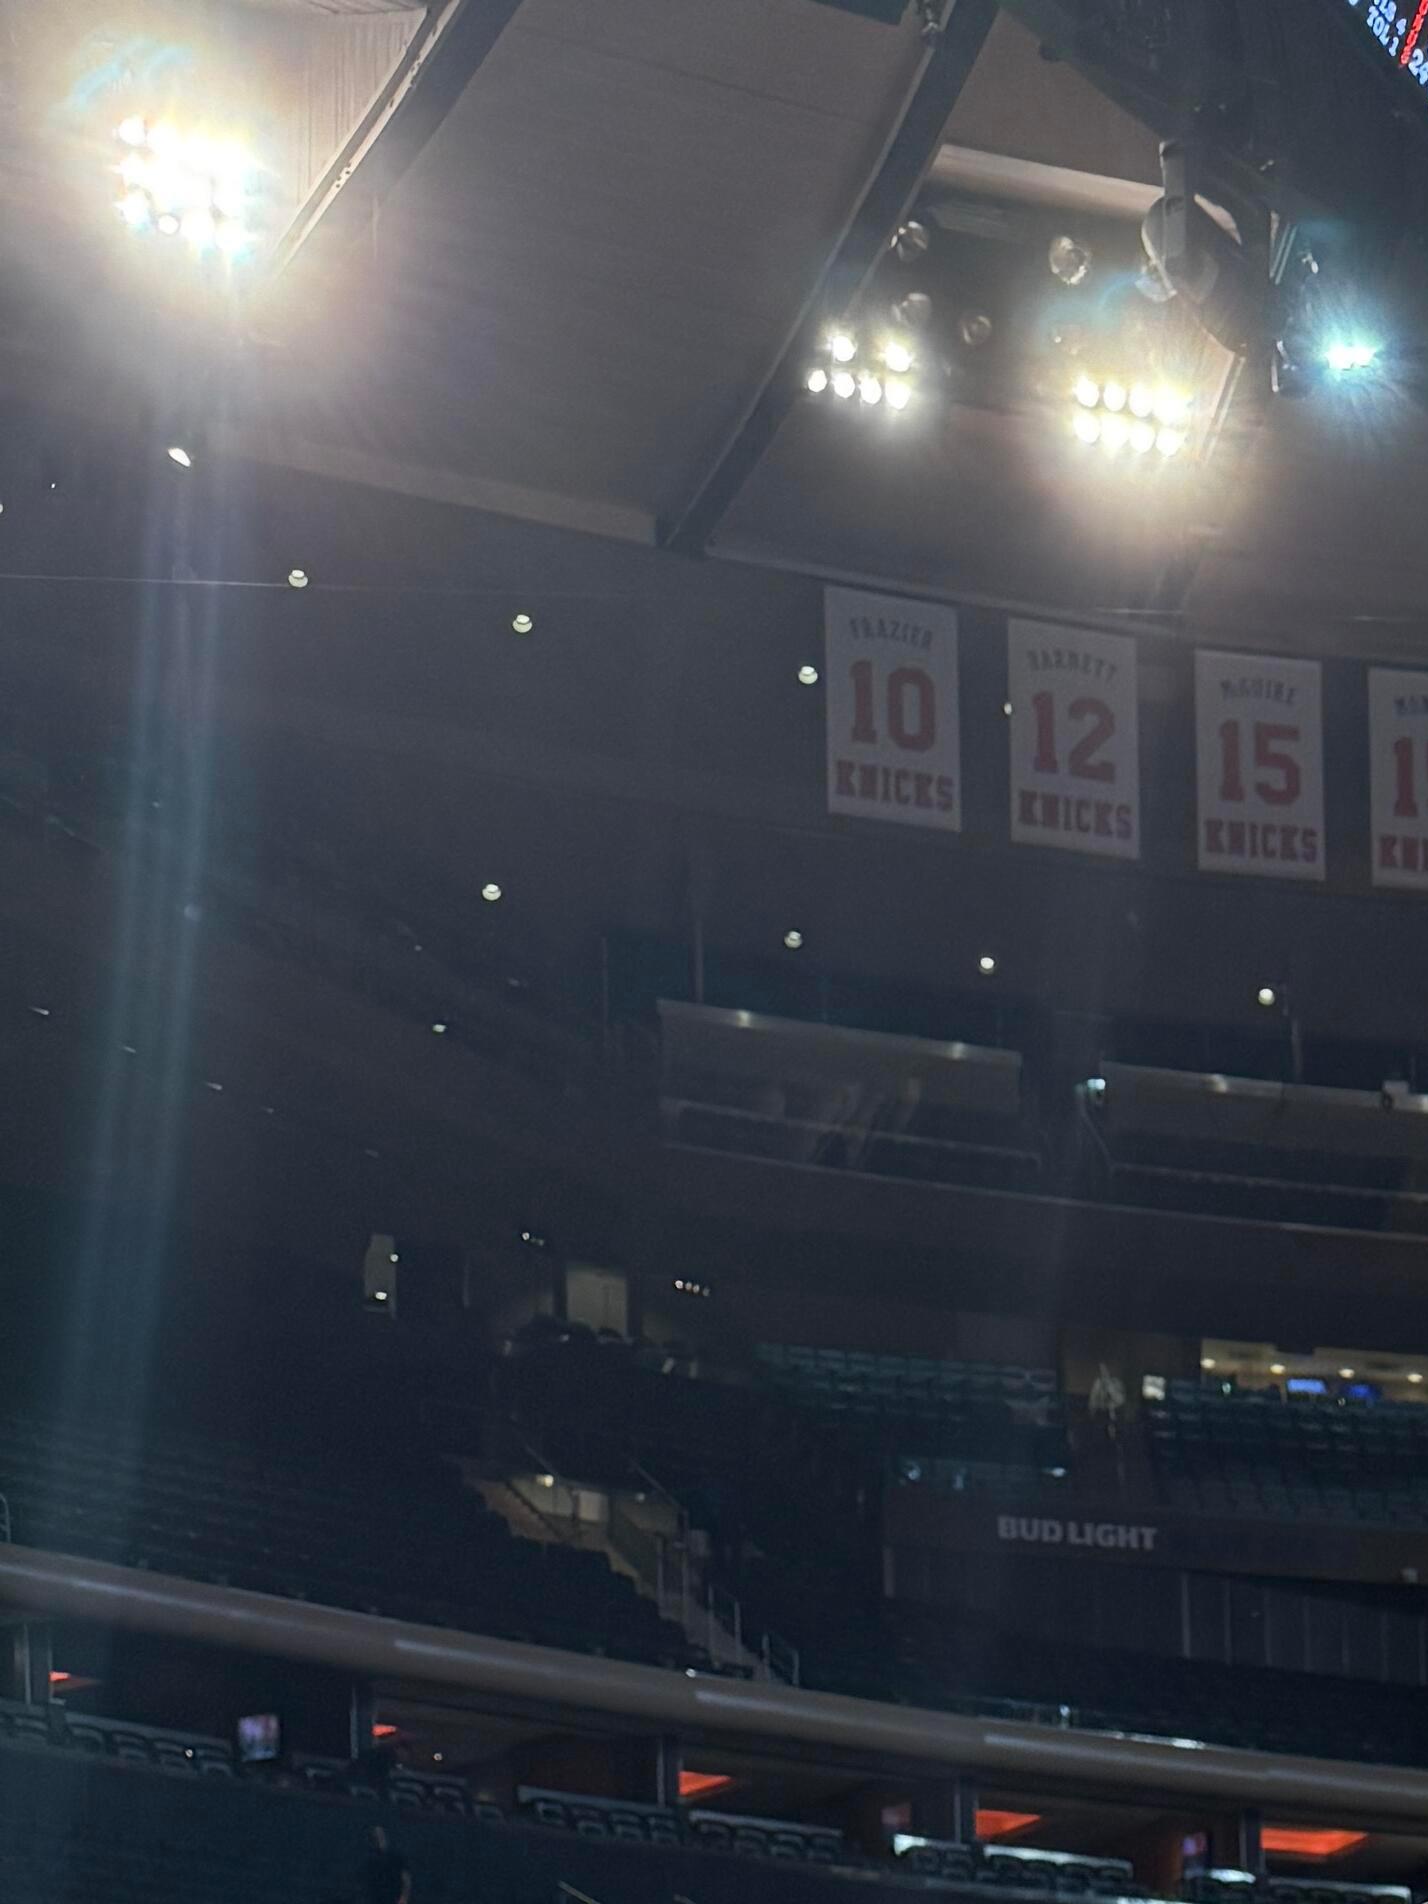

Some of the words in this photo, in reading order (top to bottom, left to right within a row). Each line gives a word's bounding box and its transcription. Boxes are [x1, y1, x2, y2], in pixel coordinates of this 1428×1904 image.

[850, 659, 936, 752] 10
[1032, 691, 1116, 785] 12
[1219, 720, 1301, 806] 15
[834, 760, 955, 812] KNICKS
[1018, 790, 1133, 841] KNICKS
[1205, 819, 1319, 864] KNICKS
[997, 1515, 1064, 1543] BUD
[1066, 1520, 1158, 1551] LIGHT
